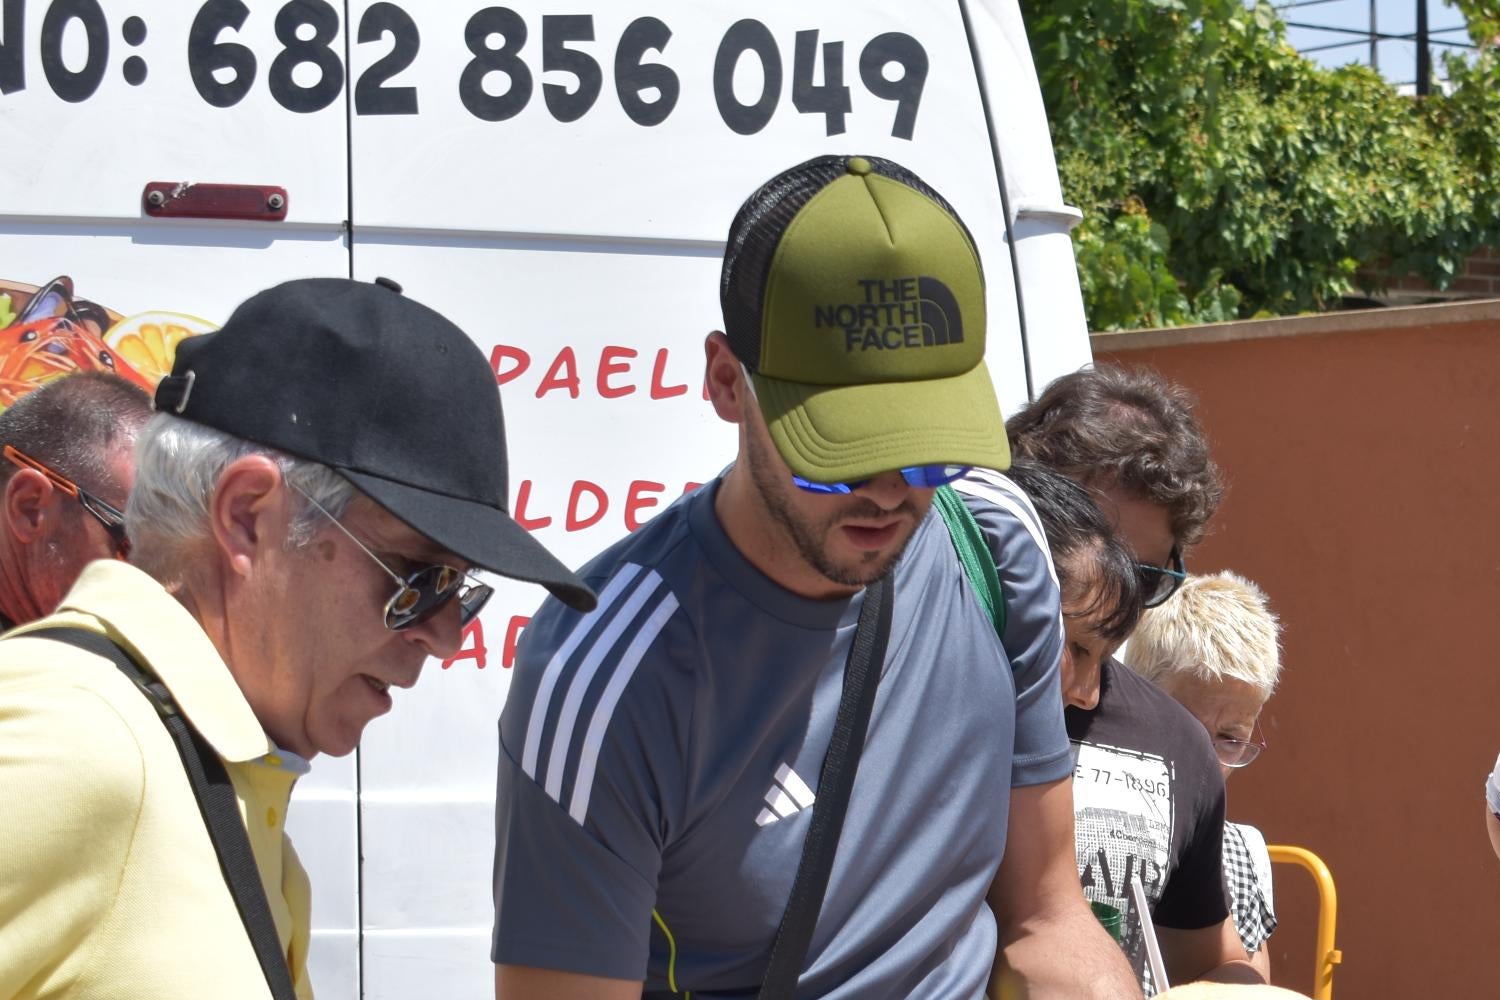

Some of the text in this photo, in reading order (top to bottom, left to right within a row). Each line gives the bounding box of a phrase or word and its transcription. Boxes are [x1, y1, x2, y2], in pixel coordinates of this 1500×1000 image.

[188, 0, 420, 115] 682
[459, 6, 680, 127] 856
[713, 18, 929, 141] 049
[858, 277, 917, 302] THE
[814, 301, 919, 328] NORTH
[846, 326, 921, 352] FACE
[489, 345, 713, 400] PAEL
[514, 480, 704, 533] LDE
